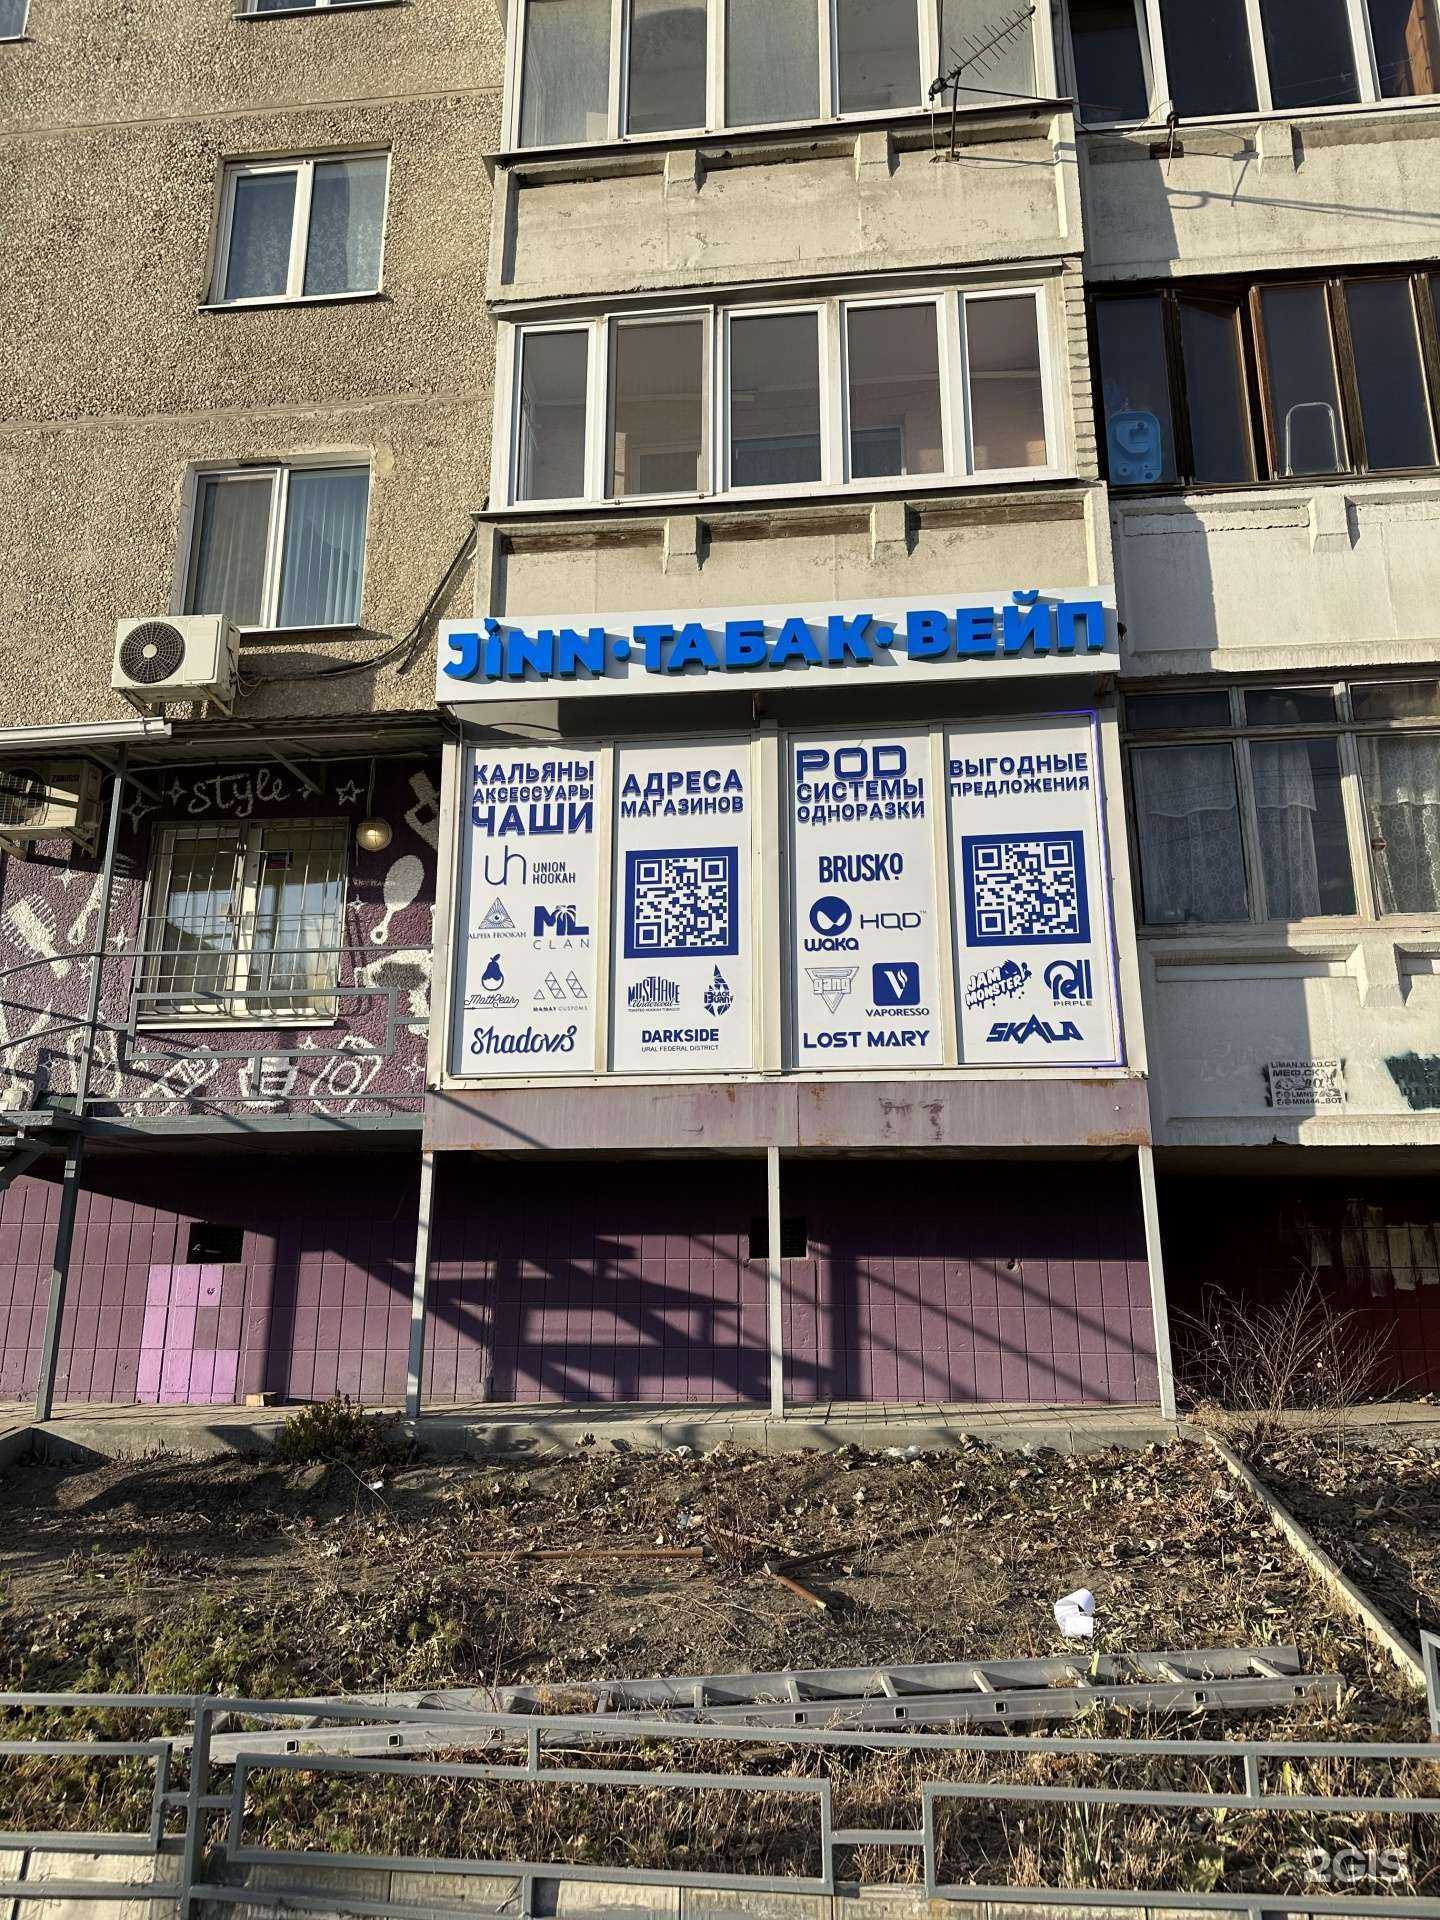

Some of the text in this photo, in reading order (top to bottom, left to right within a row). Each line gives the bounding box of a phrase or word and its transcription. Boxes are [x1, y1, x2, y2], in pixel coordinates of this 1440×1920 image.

[631, 613, 876, 673] ТАБАК
[907, 590, 1104, 661] ВЕЙП
[473, 761, 594, 785] КАЛЬЯНЫ
[796, 745, 907, 782] POD
[950, 753, 1088, 778] ВЫГОДНЫЕ
[473, 784, 593, 804] АКСЕССУАРЫ
[622, 769, 743, 799] АДРЕСА
[797, 778, 924, 803] СИСТЕМЫ
[950, 776, 1089, 798] ПРЕДЛОЖЕНИЯ
[621, 796, 744, 818] МАГАЗИНОВ
[797, 801, 925, 826] ОДНОРАЗКИ
[472, 802, 594, 837] ЧАШИ
[532, 873, 576, 884] HOOKAH
[533, 862, 566, 873] UNION
[819, 853, 904, 883] BRUSKO
[533, 938, 590, 950] CLAN
[865, 1008, 930, 1017] VAPORESSO
[642, 1028, 719, 1043] DARKSIDE
[803, 1030, 930, 1048] LOST MARY
